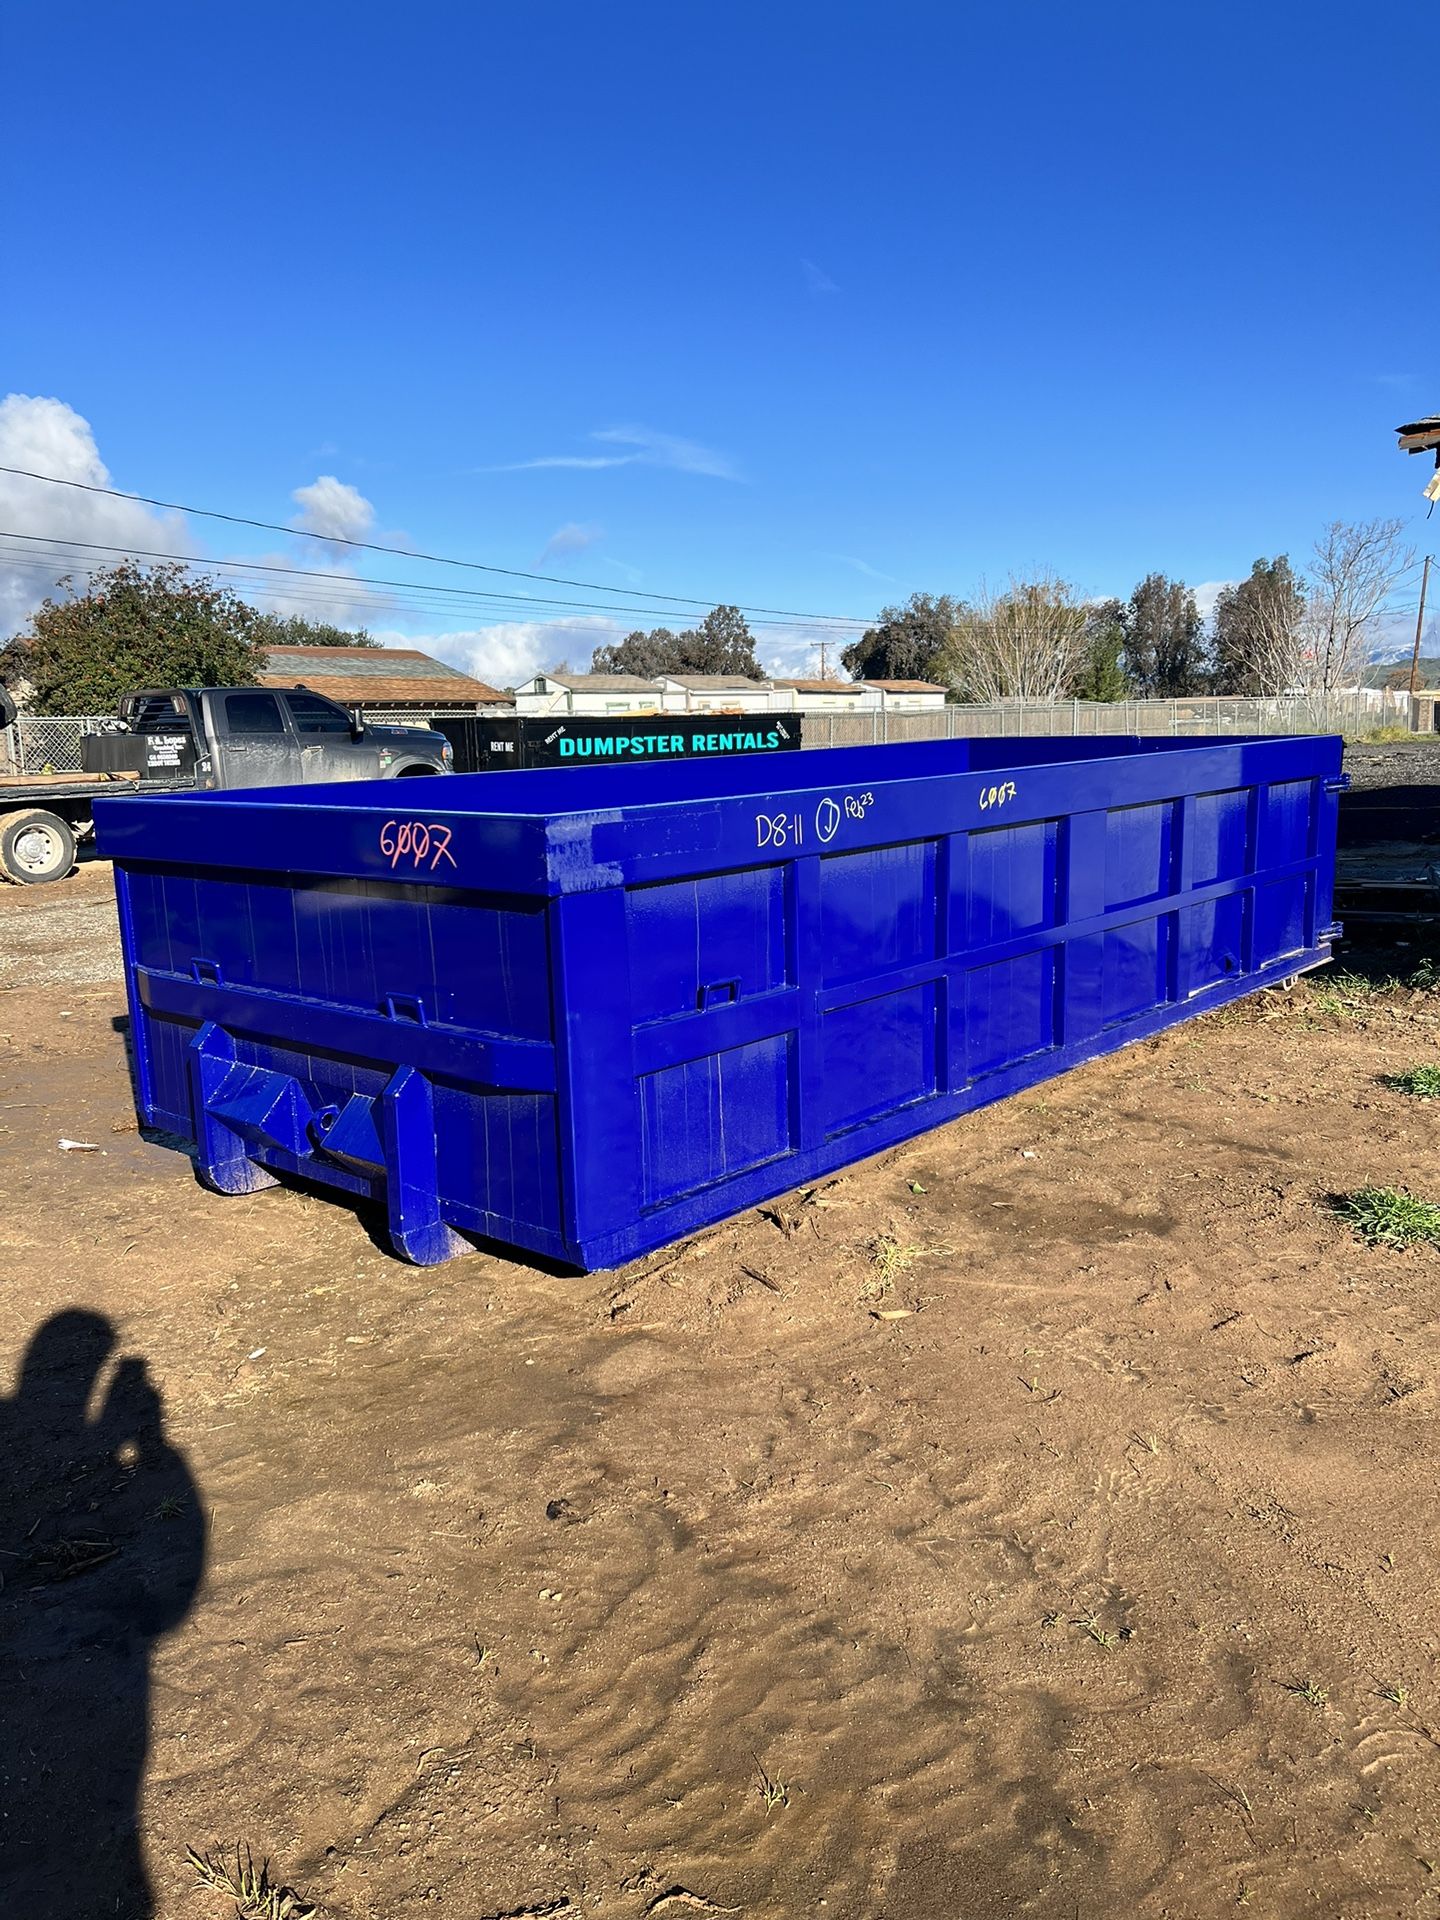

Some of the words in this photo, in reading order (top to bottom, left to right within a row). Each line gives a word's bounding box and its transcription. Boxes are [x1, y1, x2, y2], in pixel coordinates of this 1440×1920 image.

[544, 730, 558, 745] RENT
[556, 725, 567, 736] ME
[559, 735, 685, 757] DUMPSTER
[692, 731, 780, 752] RENTALS
[490, 741, 504, 752] RENT
[505, 741, 514, 752] ME
